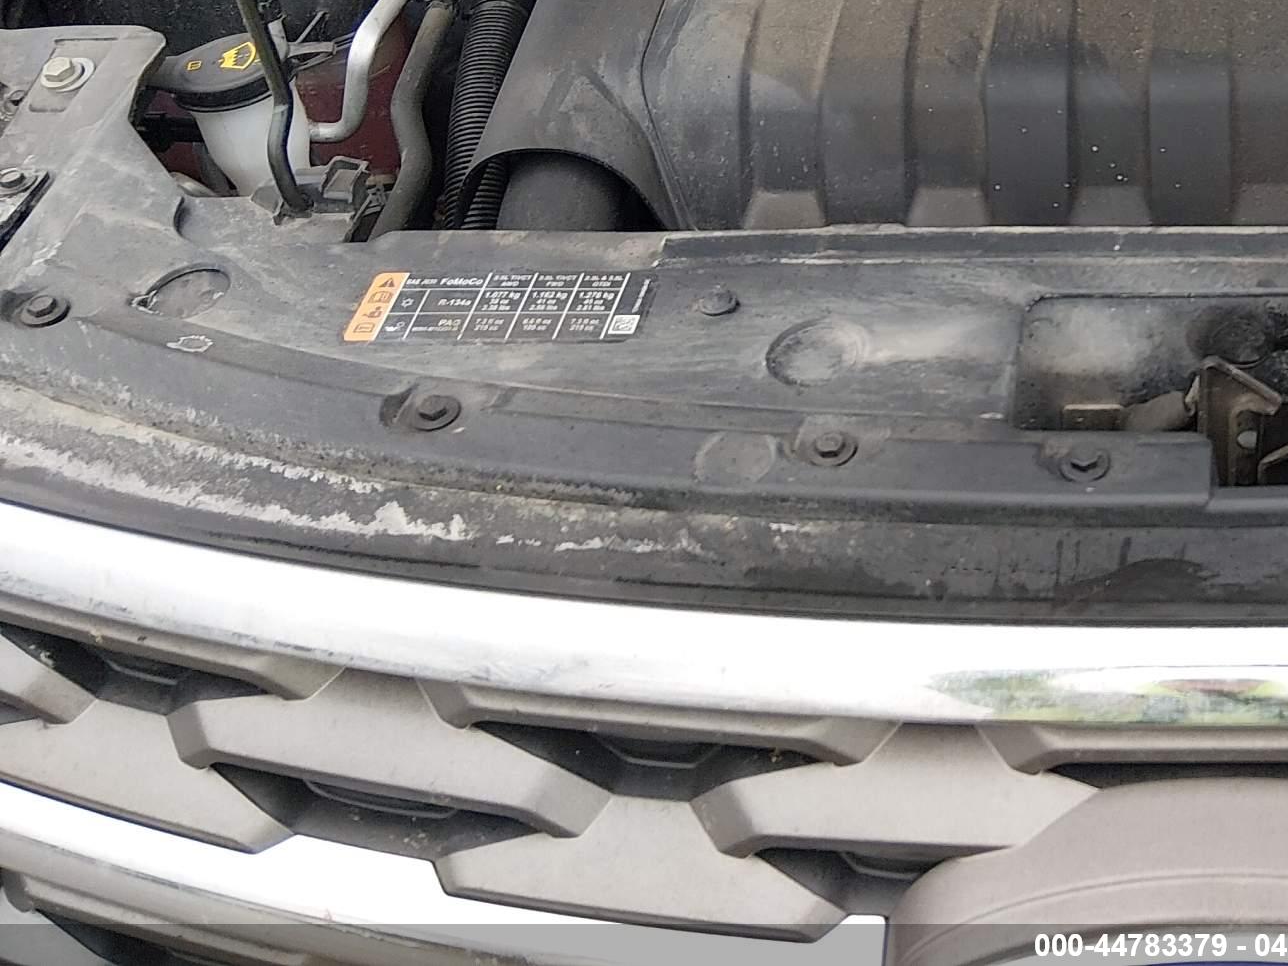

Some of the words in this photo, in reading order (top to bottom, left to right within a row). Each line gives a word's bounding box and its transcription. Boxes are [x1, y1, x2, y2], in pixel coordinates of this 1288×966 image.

[439, 277, 484, 286] FoMoCo
[508, 291, 521, 300] kg
[555, 291, 569, 300] kg
[602, 291, 615, 301] kg
[437, 298, 472, 306] R-134a
